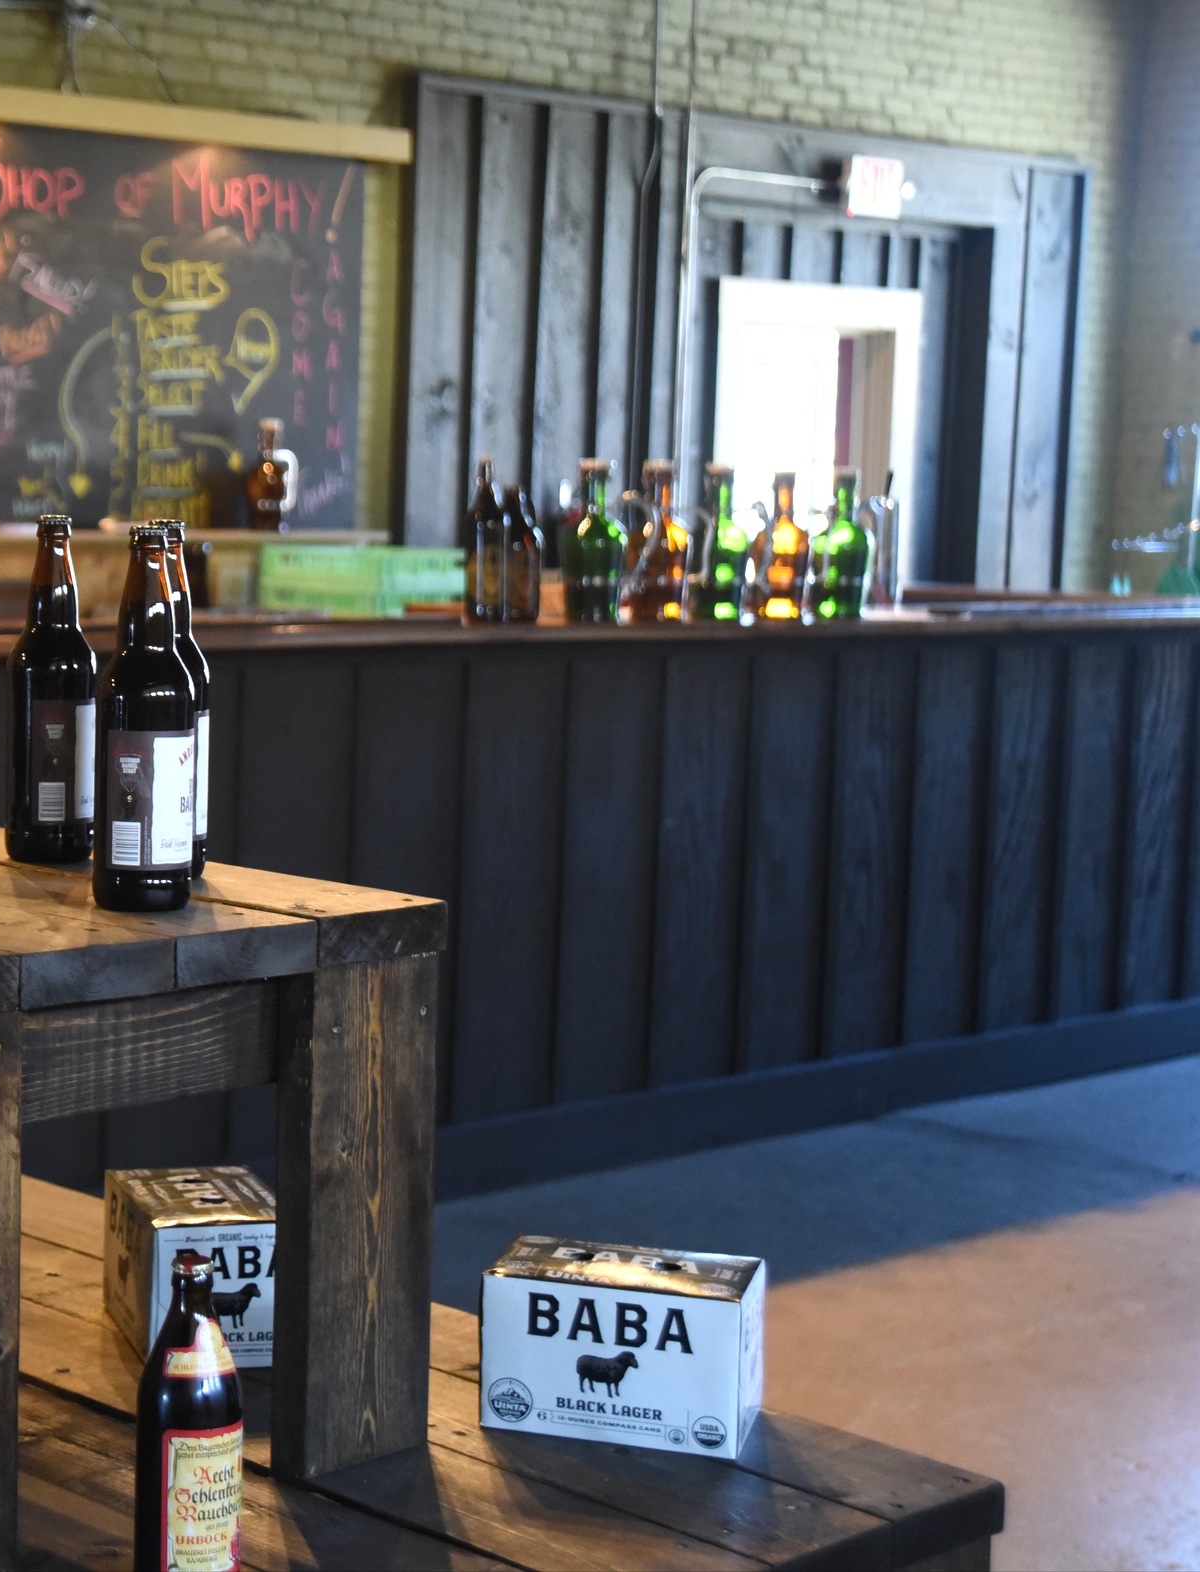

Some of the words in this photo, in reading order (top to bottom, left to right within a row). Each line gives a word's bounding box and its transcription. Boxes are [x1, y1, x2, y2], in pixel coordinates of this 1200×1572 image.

[132, 236, 230, 309] STEPS
[218, 1232, 242, 1243] ORGANIC
[176, 1245, 275, 1280] AB
[527, 1291, 693, 1354] BABA
[248, 1332, 272, 1342] LAG
[494, 1400, 528, 1413] UINTA
[556, 1397, 606, 1415] BLACK
[612, 1404, 662, 1421] LAGER
[537, 1411, 546, 1421] 6
[597, 1420, 637, 1430] COMPASS
[700, 1423, 719, 1433] USDA
[193, 1465, 235, 1485] Aecht
[176, 1531, 227, 1545] URBOCK
